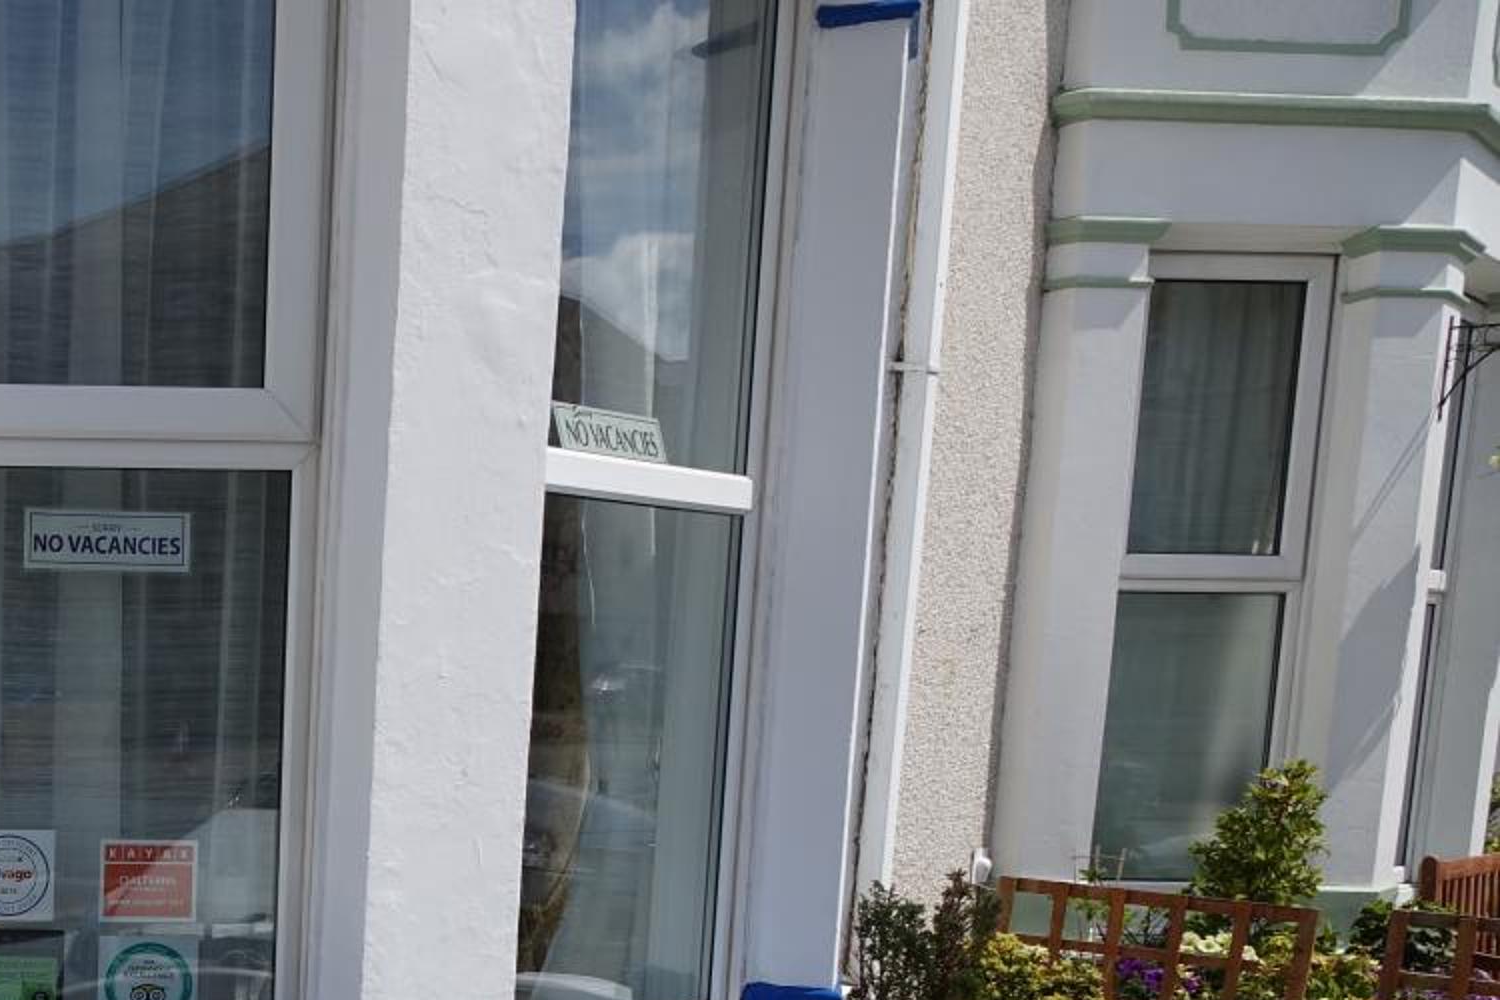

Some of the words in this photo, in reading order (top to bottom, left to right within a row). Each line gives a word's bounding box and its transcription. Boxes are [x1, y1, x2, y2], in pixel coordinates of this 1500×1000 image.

[565, 419, 589, 447] NO
[589, 422, 659, 457] VACANCIES
[33, 534, 64, 553] NO
[67, 535, 181, 555] VACANCIES
